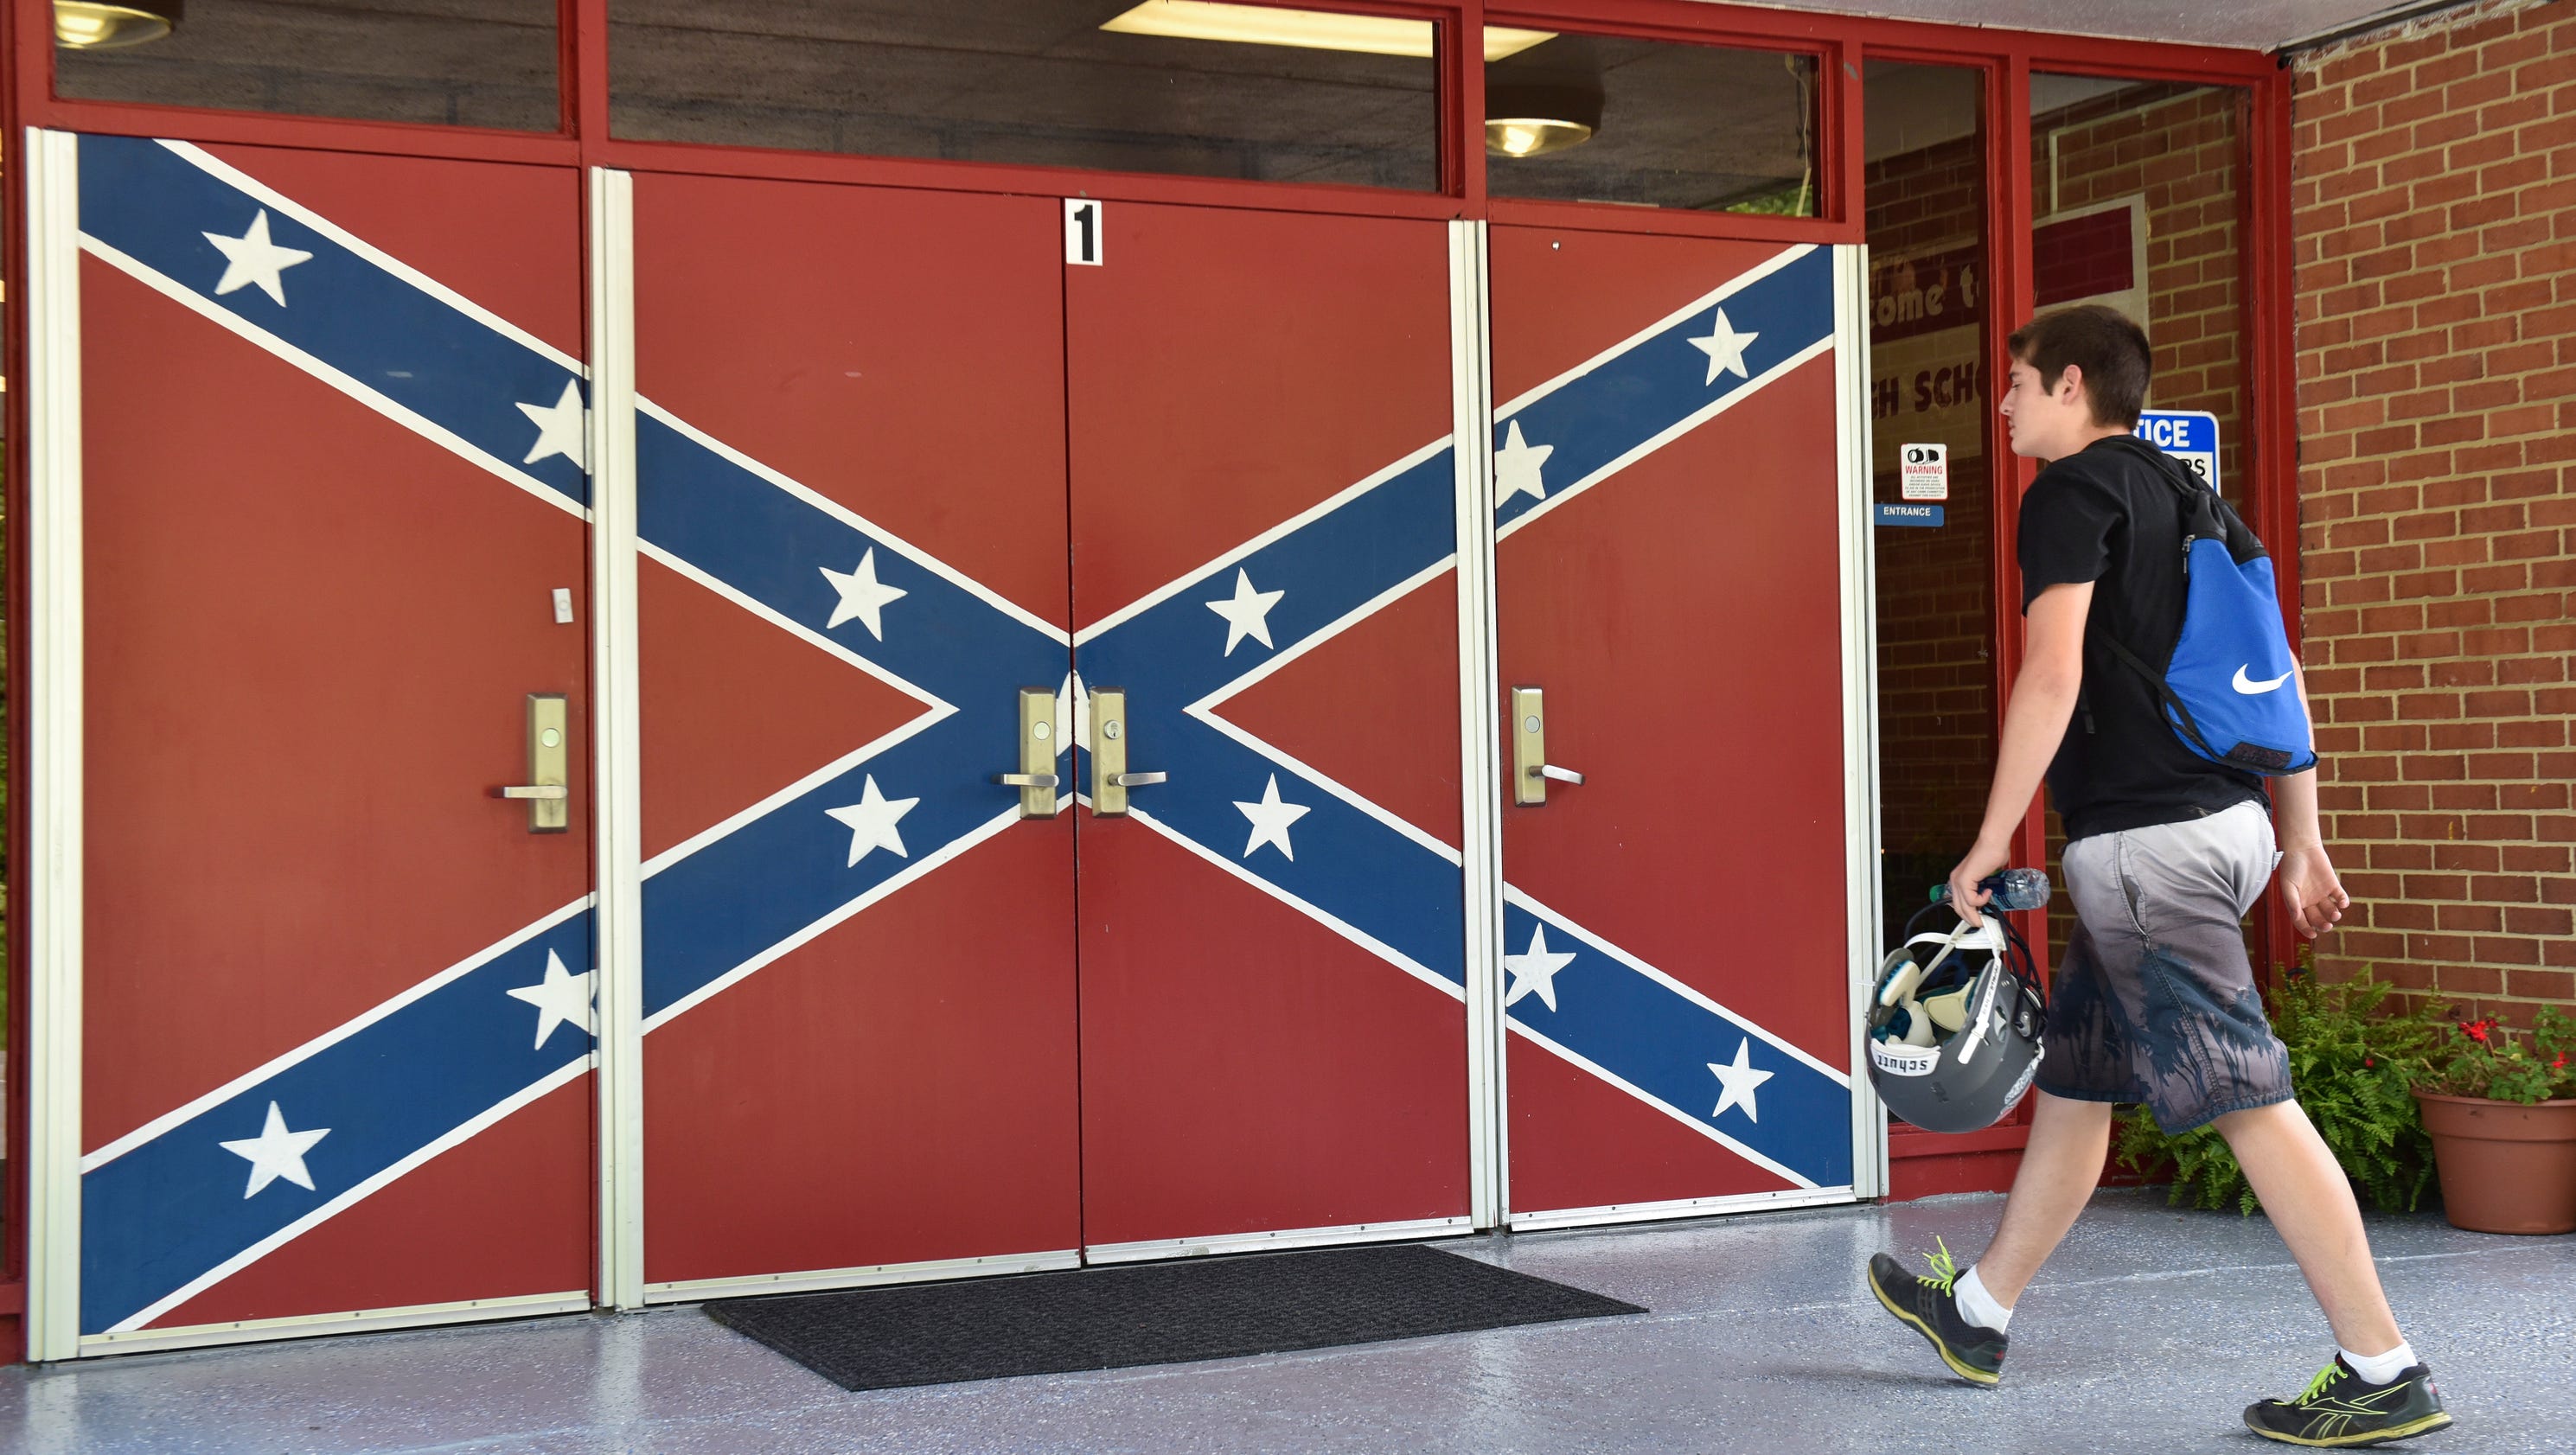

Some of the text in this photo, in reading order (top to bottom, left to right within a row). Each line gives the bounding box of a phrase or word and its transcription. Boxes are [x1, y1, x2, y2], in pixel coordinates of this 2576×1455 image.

[1074, 204, 1094, 262] 1
[1960, 264, 1979, 308] t
[1914, 361, 1979, 412] SCH
[1905, 465, 1943, 474] WARNING
[1883, 506, 1931, 516] ENTRANCE
[1877, 1055, 1927, 1073] schutt
